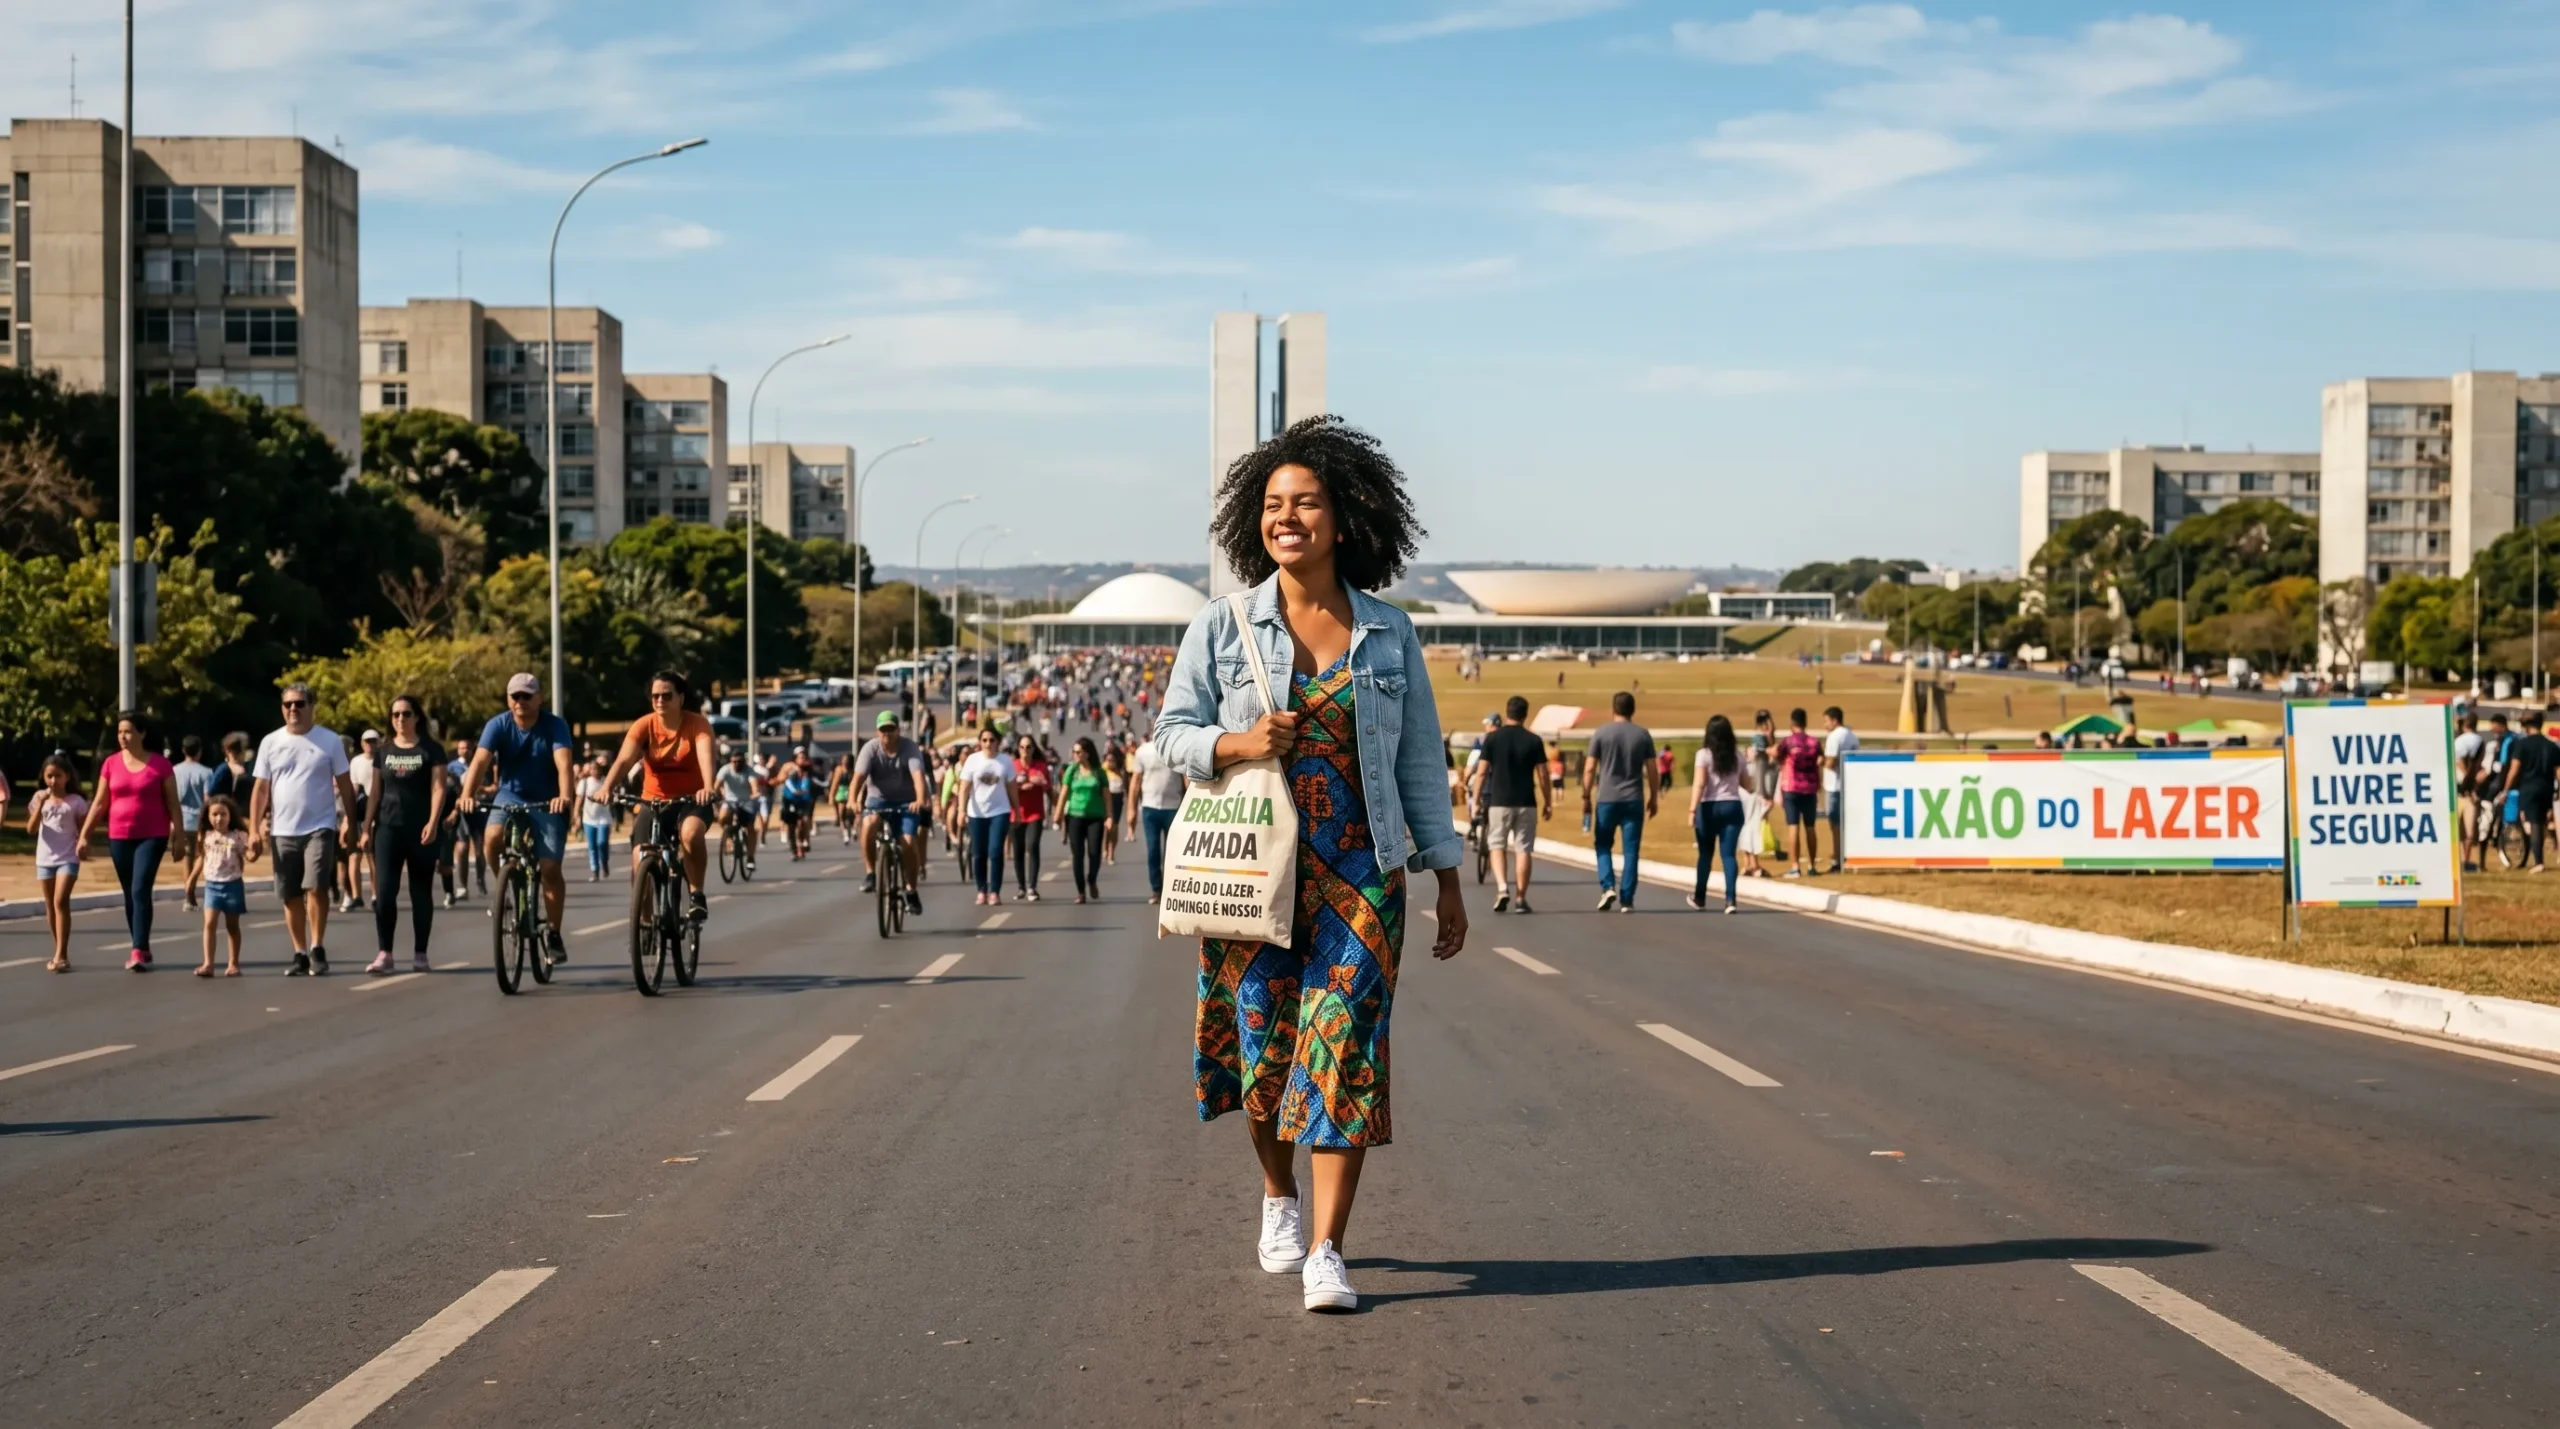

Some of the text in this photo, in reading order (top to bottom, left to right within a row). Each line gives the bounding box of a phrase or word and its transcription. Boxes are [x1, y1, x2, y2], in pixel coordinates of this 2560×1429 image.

[2332, 734, 2408, 765] VIVA
[2312, 773, 2432, 805] LIVRE E
[1183, 791, 1273, 826] BRASÍLIA
[1873, 775, 2260, 839] EIXÃO DO LAZER
[2310, 813, 2438, 845] SEGURA
[1183, 830, 1257, 860] AMADA
[1203, 882, 1217, 895] DO
[1220, 883, 1254, 898] LAZER
[1166, 898, 1262, 919] DOMINGO É NOSSO!
